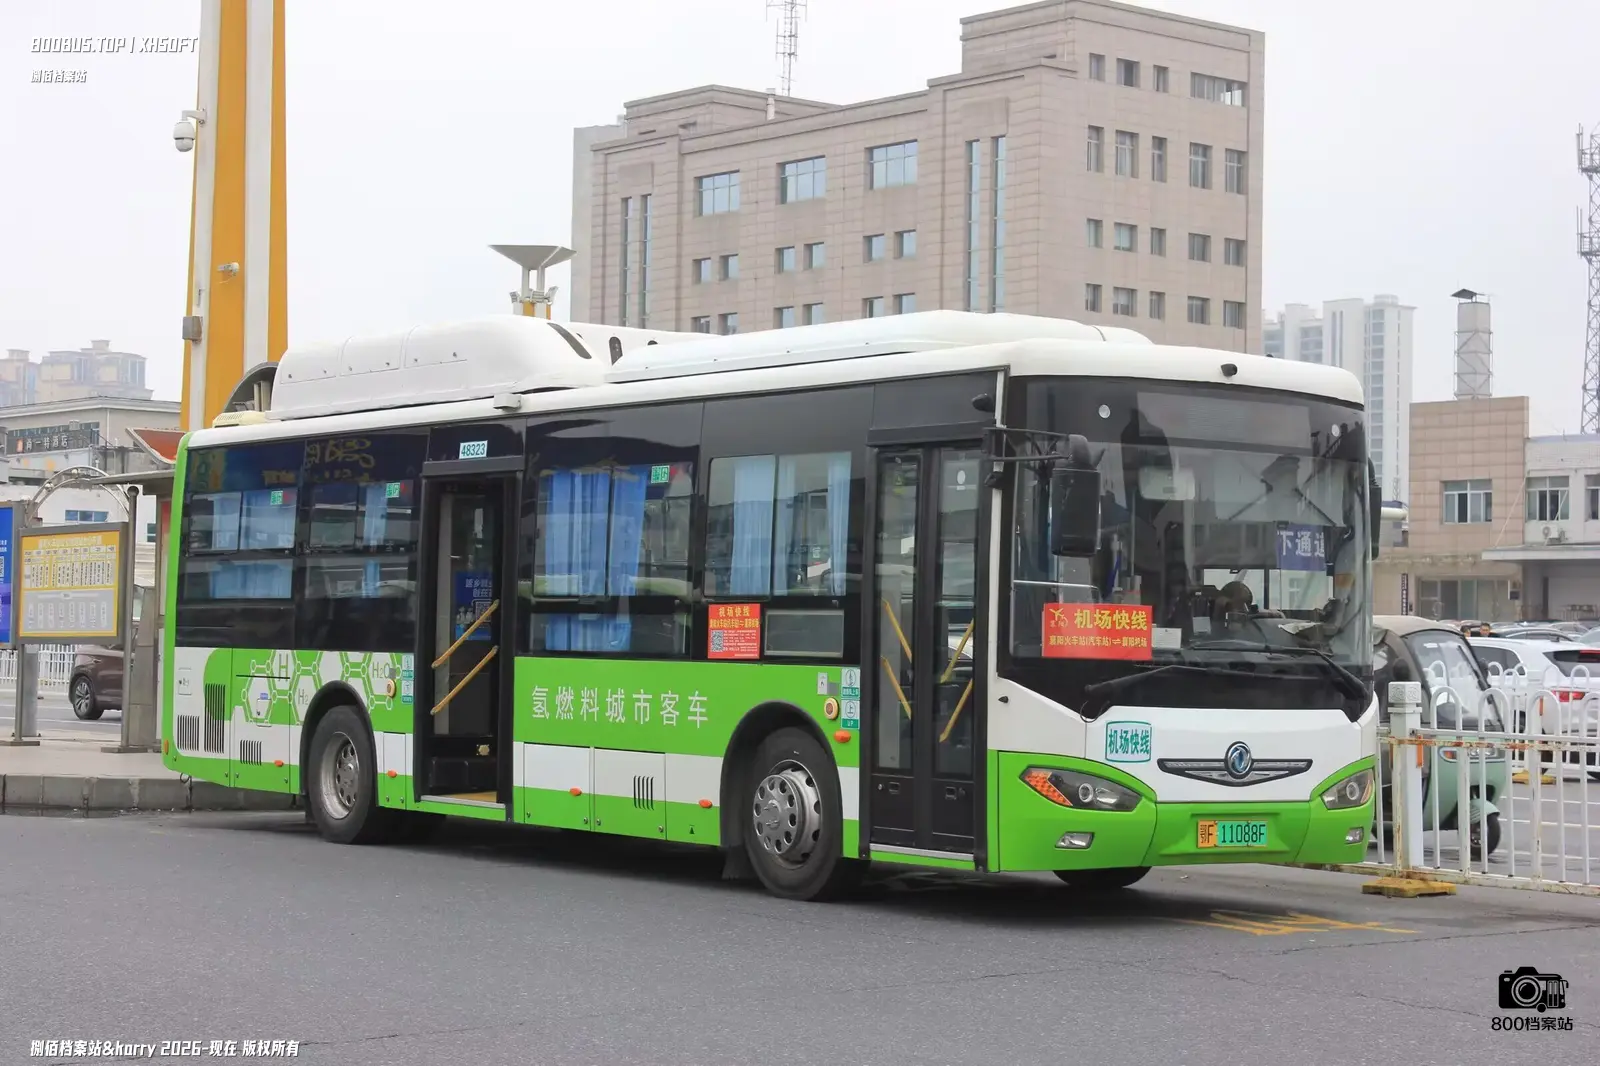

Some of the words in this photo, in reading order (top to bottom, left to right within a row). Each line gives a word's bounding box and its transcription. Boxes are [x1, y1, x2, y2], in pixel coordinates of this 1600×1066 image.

[461, 443, 485, 456] 48323
[1277, 530, 1325, 557] 下通道
[719, 606, 750, 617] 机场快线
[1074, 608, 1148, 630] 机场快线
[532, 685, 708, 729] 氢燃料城市客车
[1108, 728, 1150, 755] 机场快线
[1221, 824, 1266, 843] 11088F
